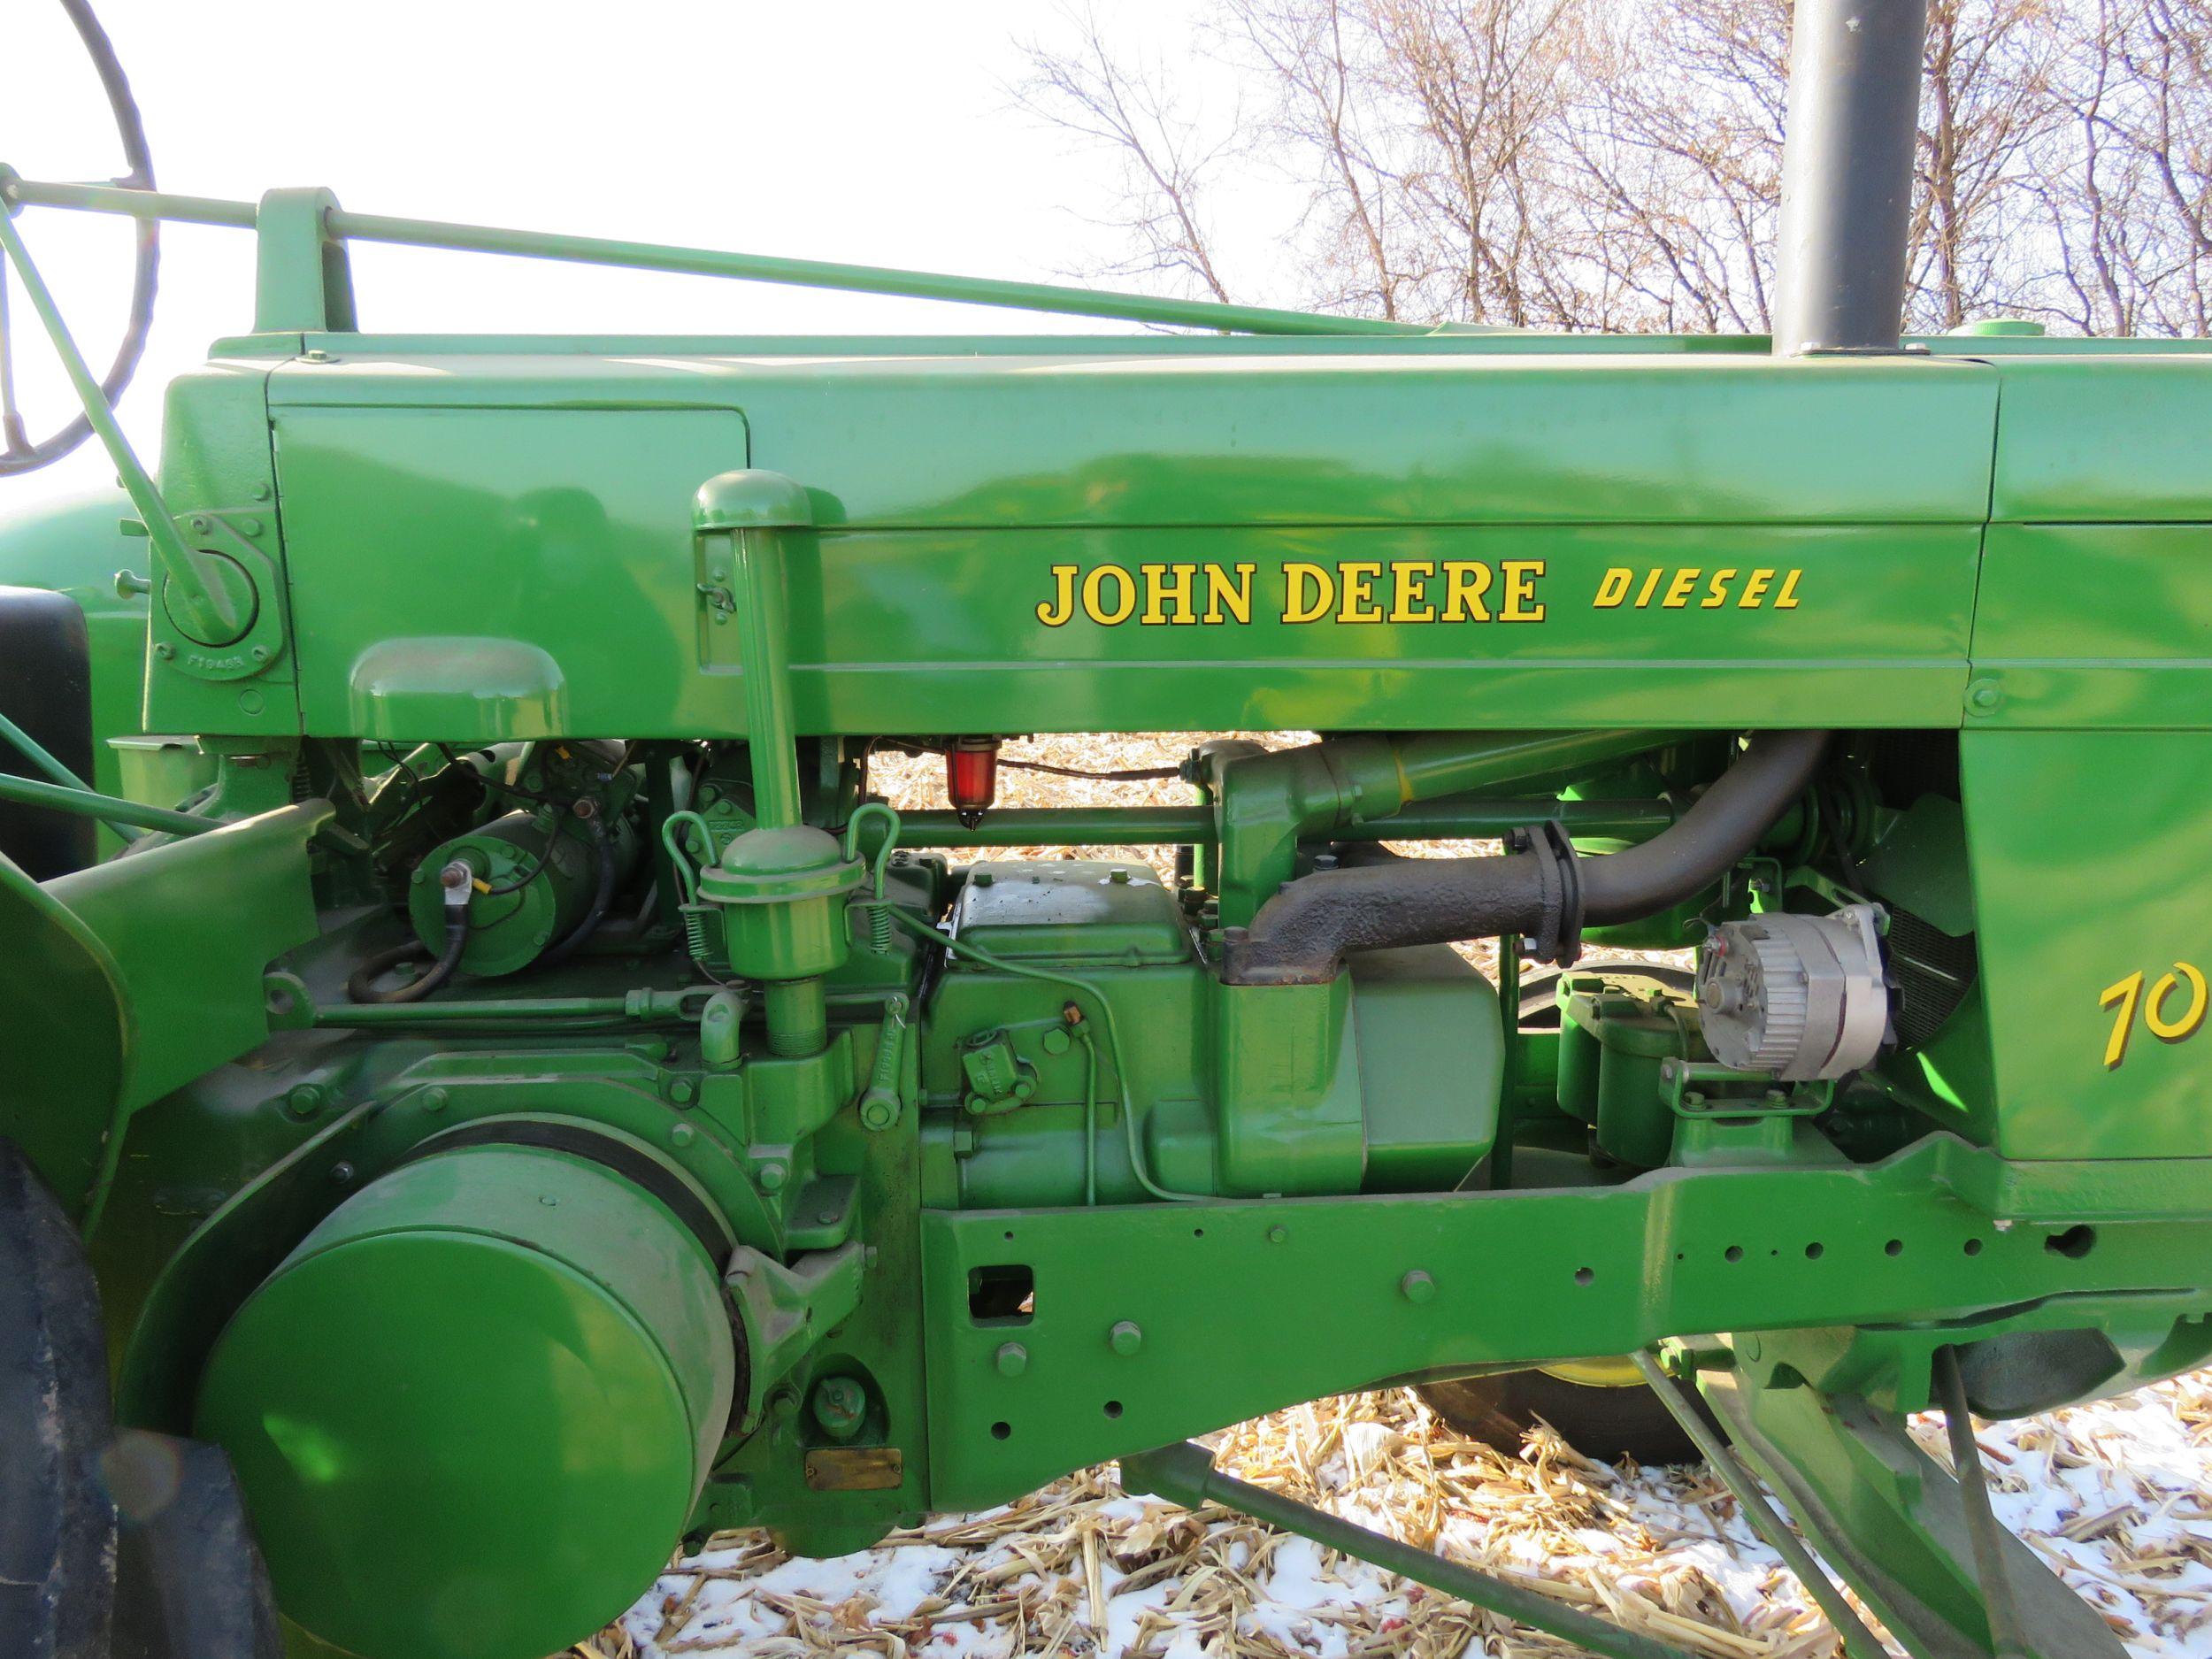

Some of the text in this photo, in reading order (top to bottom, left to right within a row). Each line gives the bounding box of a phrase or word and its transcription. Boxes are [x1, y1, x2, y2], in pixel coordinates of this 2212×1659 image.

[1035, 559, 1802, 626] JOHN DEERE DIESEL
[2098, 961, 2209, 1072] 70
